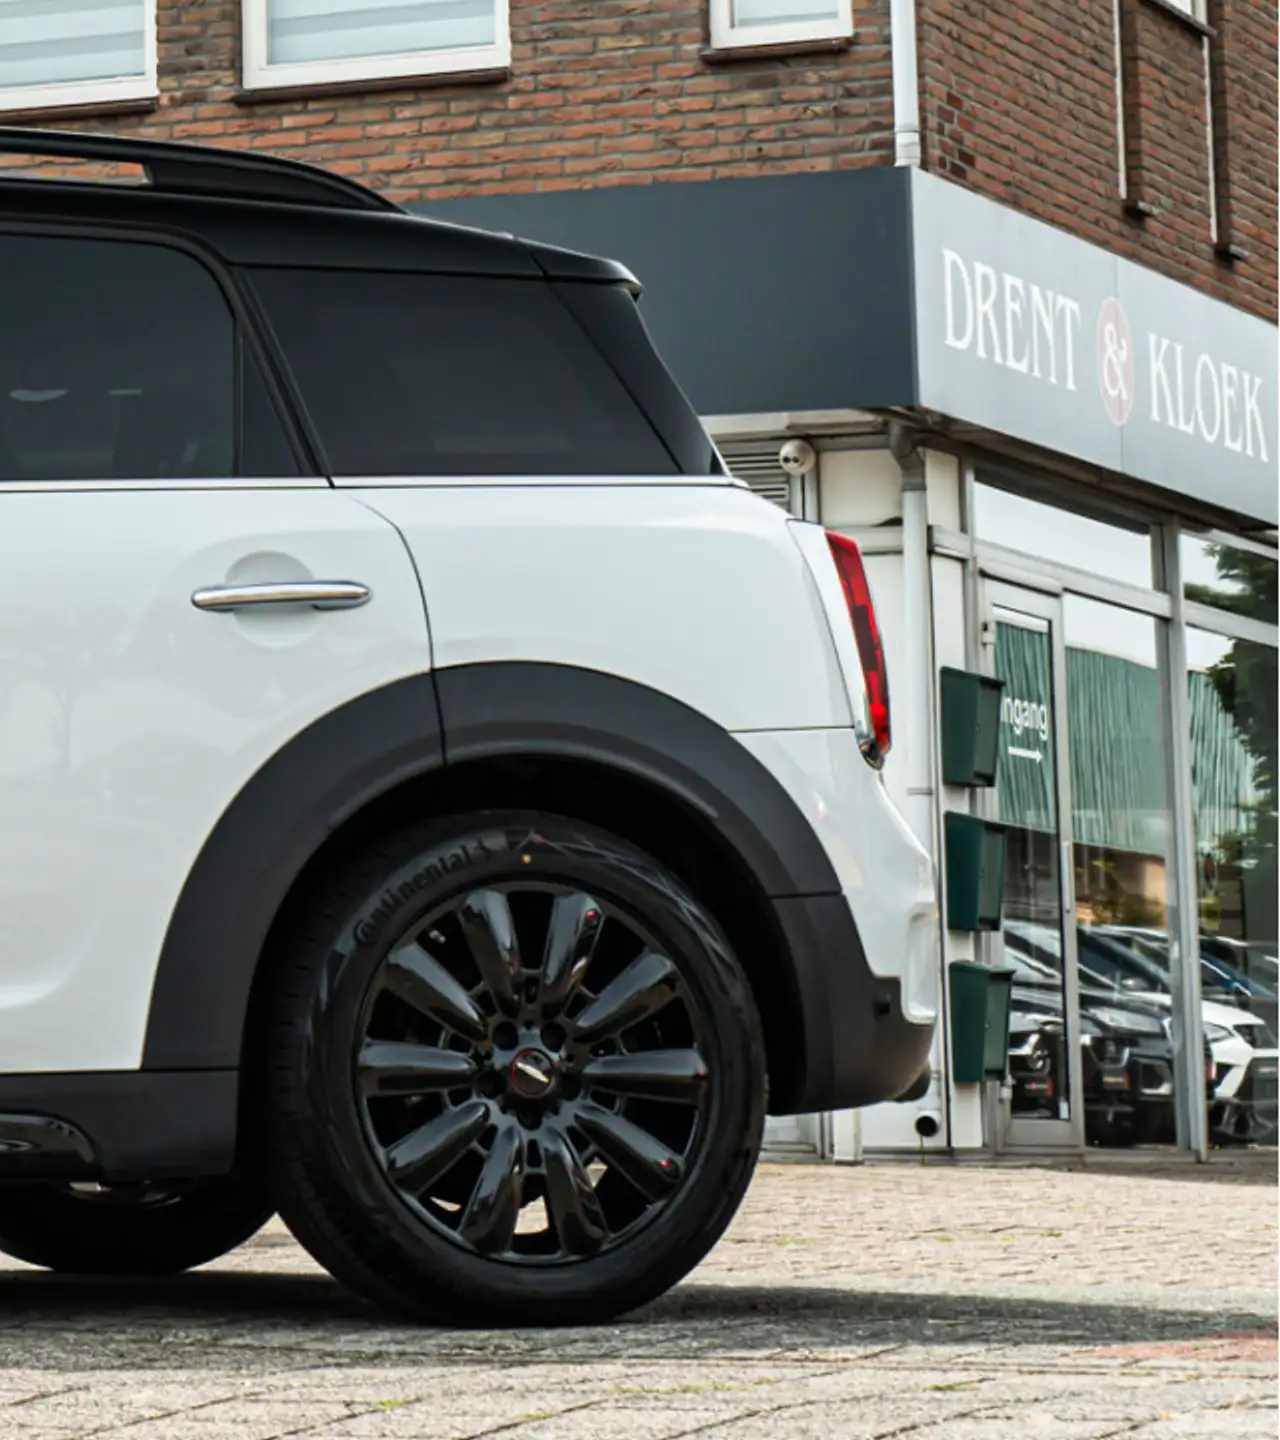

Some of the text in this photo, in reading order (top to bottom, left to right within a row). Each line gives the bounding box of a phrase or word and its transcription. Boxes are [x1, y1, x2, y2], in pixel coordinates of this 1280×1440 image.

[942, 247, 1269, 463] DRENT & KLOEK
